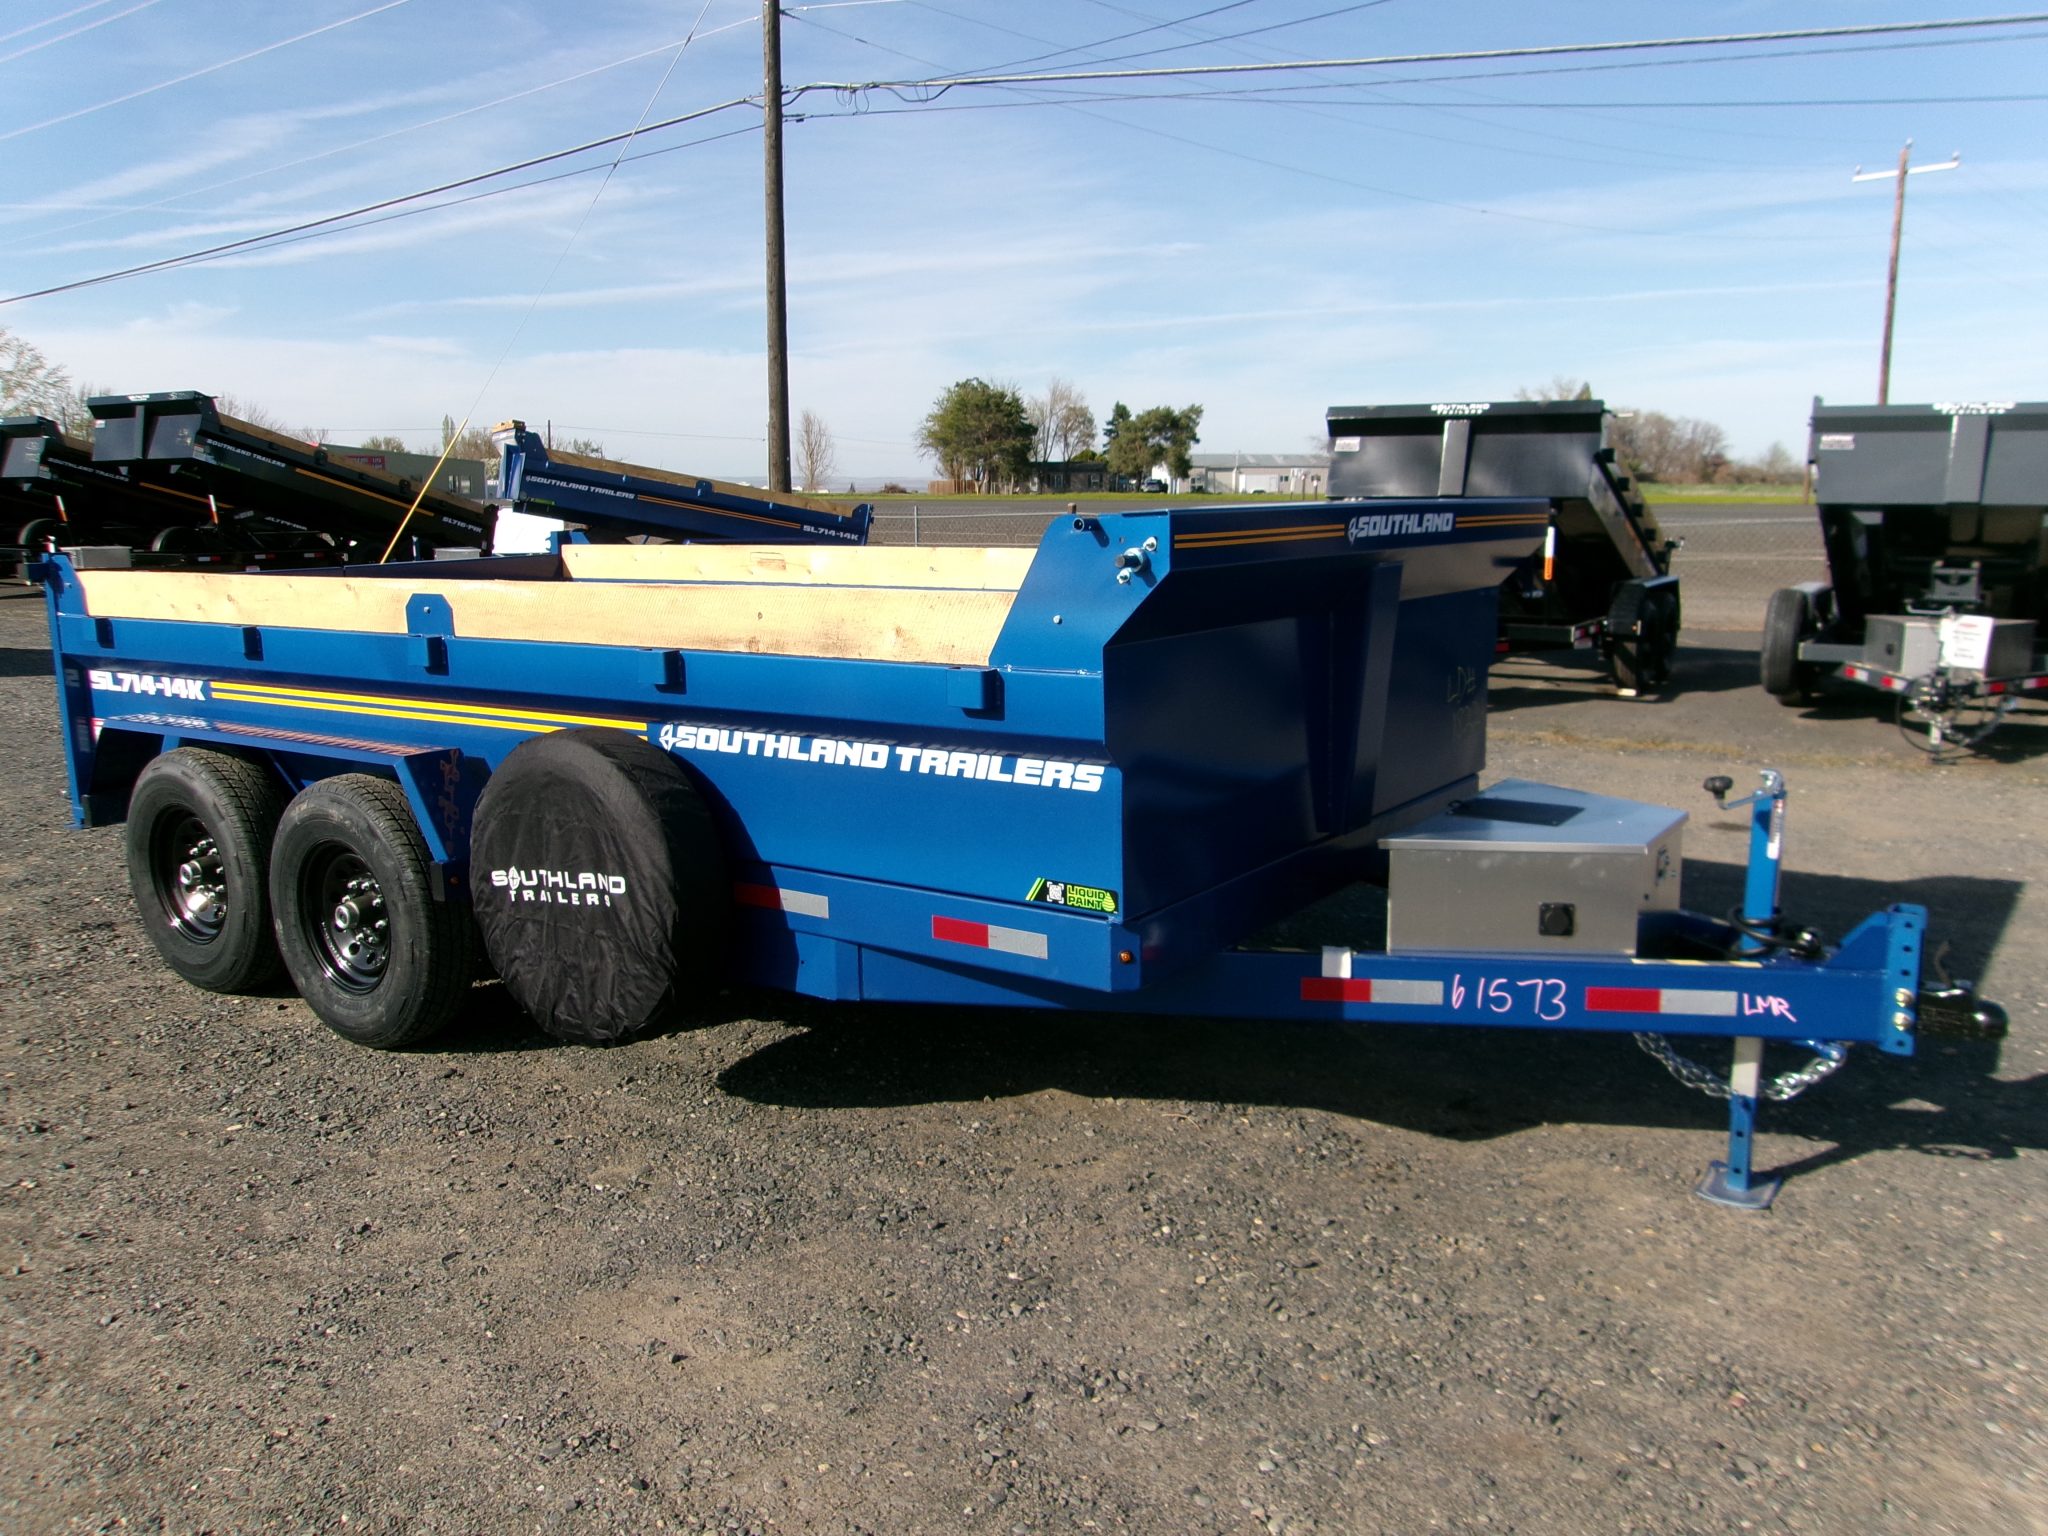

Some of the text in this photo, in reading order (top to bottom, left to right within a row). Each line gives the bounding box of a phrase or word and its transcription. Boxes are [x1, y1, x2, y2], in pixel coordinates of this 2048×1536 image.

[206, 437, 251, 458] SOUTHLAND
[252, 452, 286, 469] TRAILERS
[529, 475, 636, 500] SOUTHLAND TRAILERS
[802, 524, 860, 541] SL714-14K
[1356, 512, 1454, 538] SOUTHLAND
[88, 669, 206, 701] SL714-14K
[674, 725, 1105, 793] SOUTHLAND TRAILERS
[491, 866, 626, 895] SOUTHLAND
[1066, 884, 1106, 900] LIQUID
[1066, 895, 1104, 911] PAINT
[1742, 993, 1797, 1023] LMR
